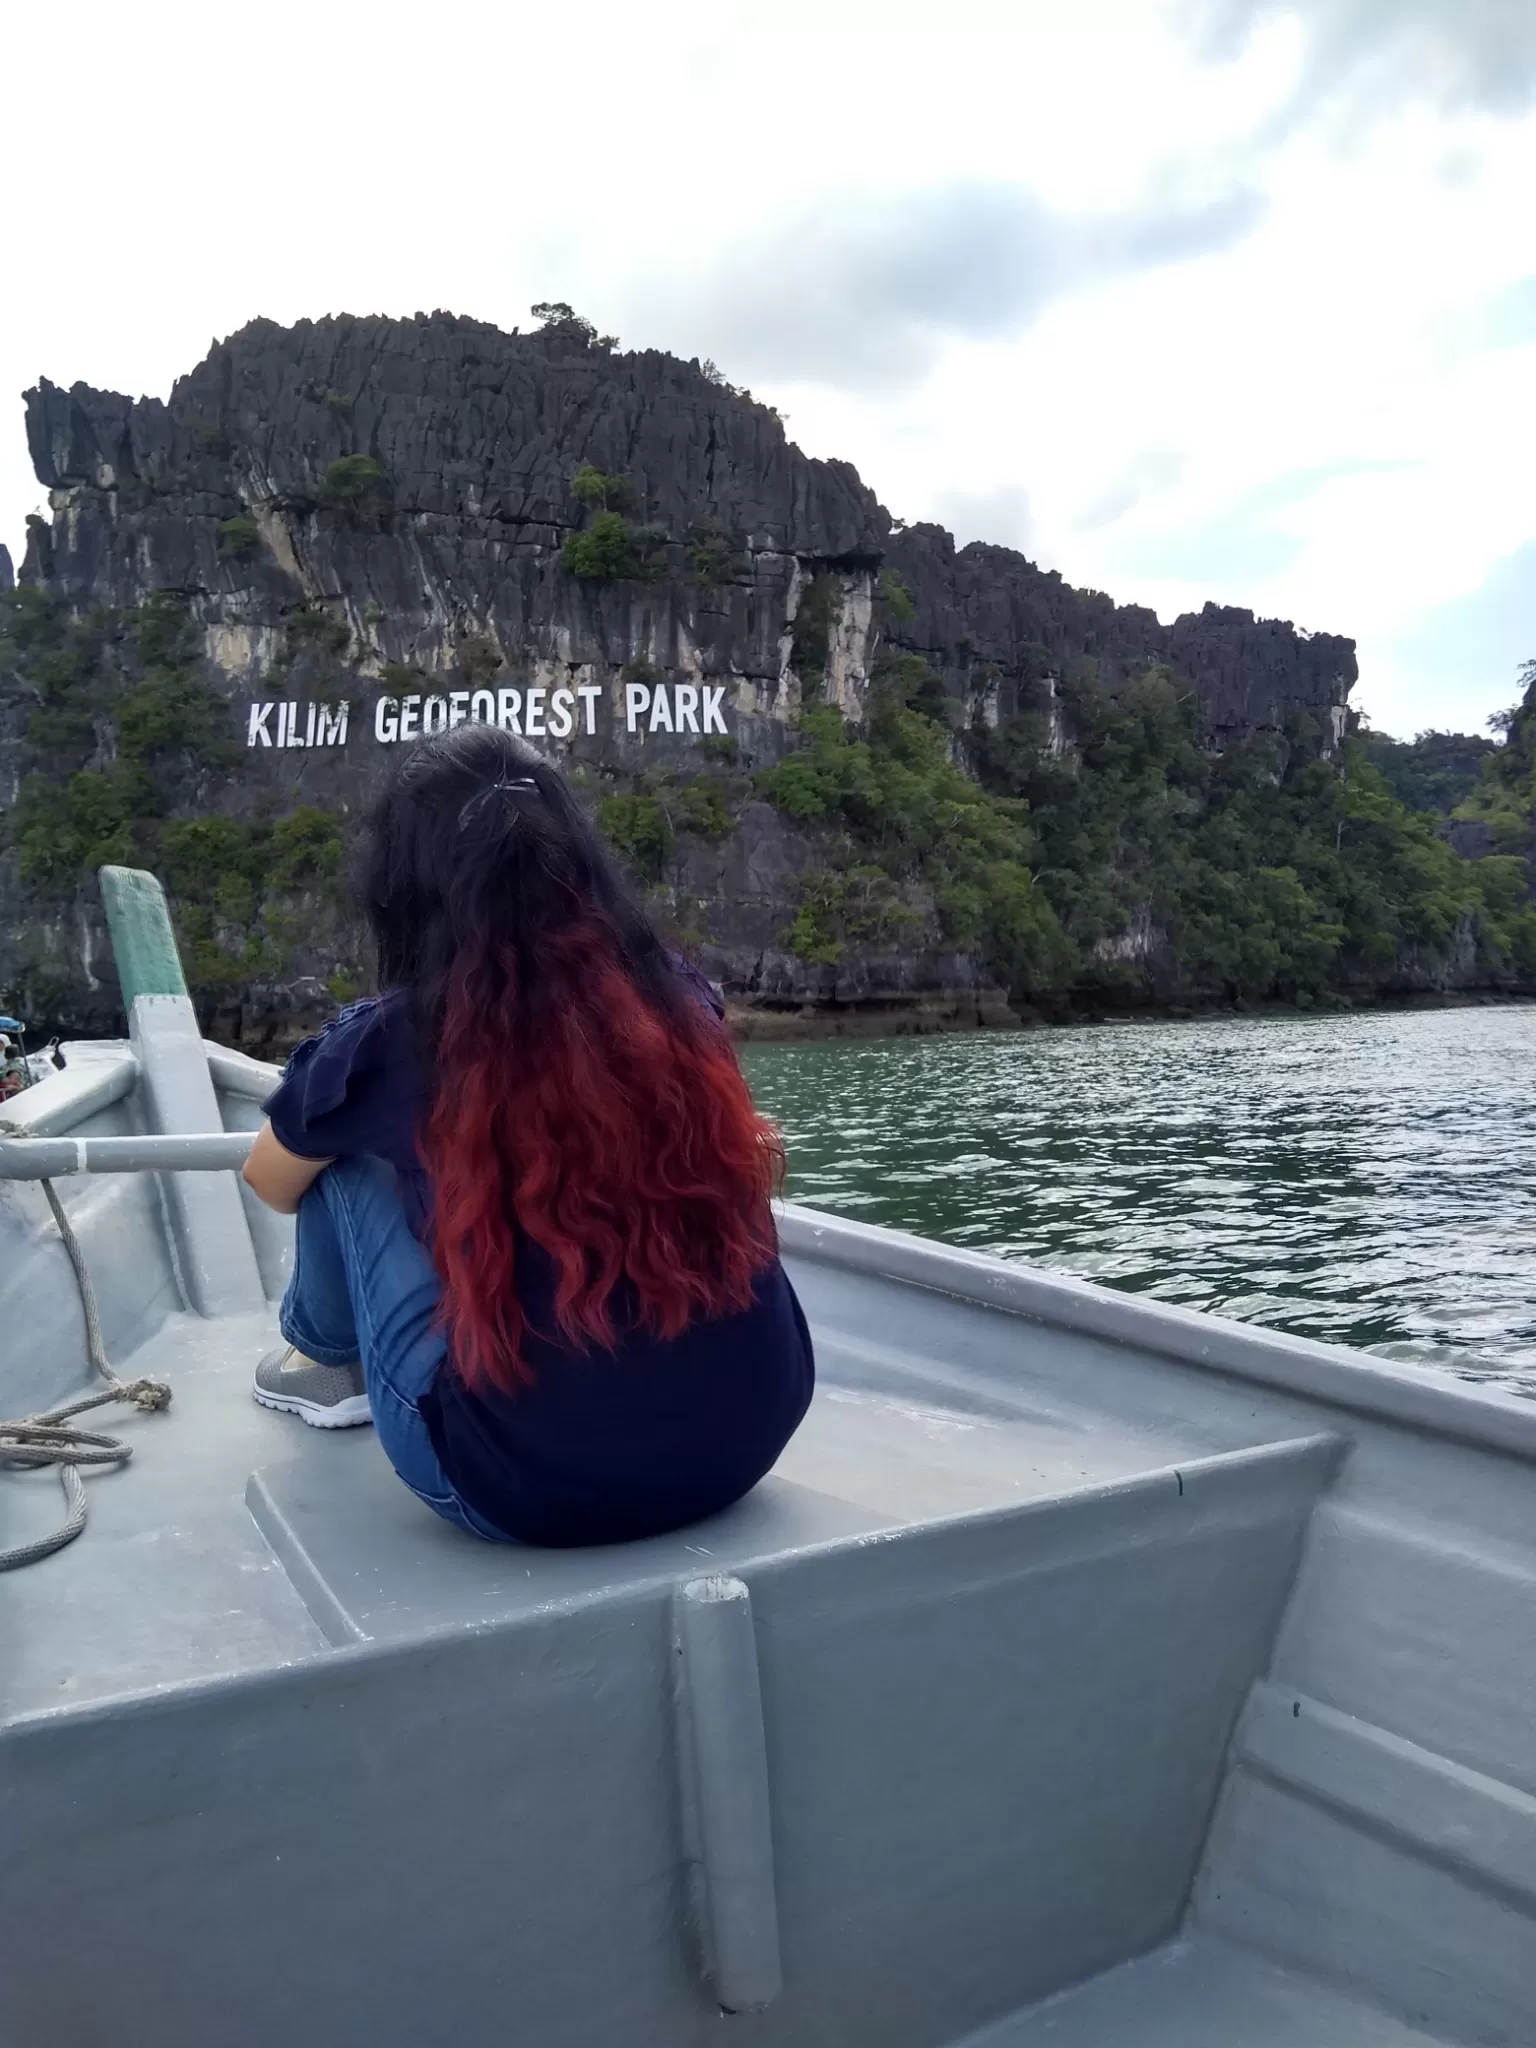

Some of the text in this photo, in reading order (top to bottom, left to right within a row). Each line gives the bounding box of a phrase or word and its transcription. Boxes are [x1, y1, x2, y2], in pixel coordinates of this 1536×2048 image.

[247, 682, 729, 748] KILIM GEOFOREST PARK
